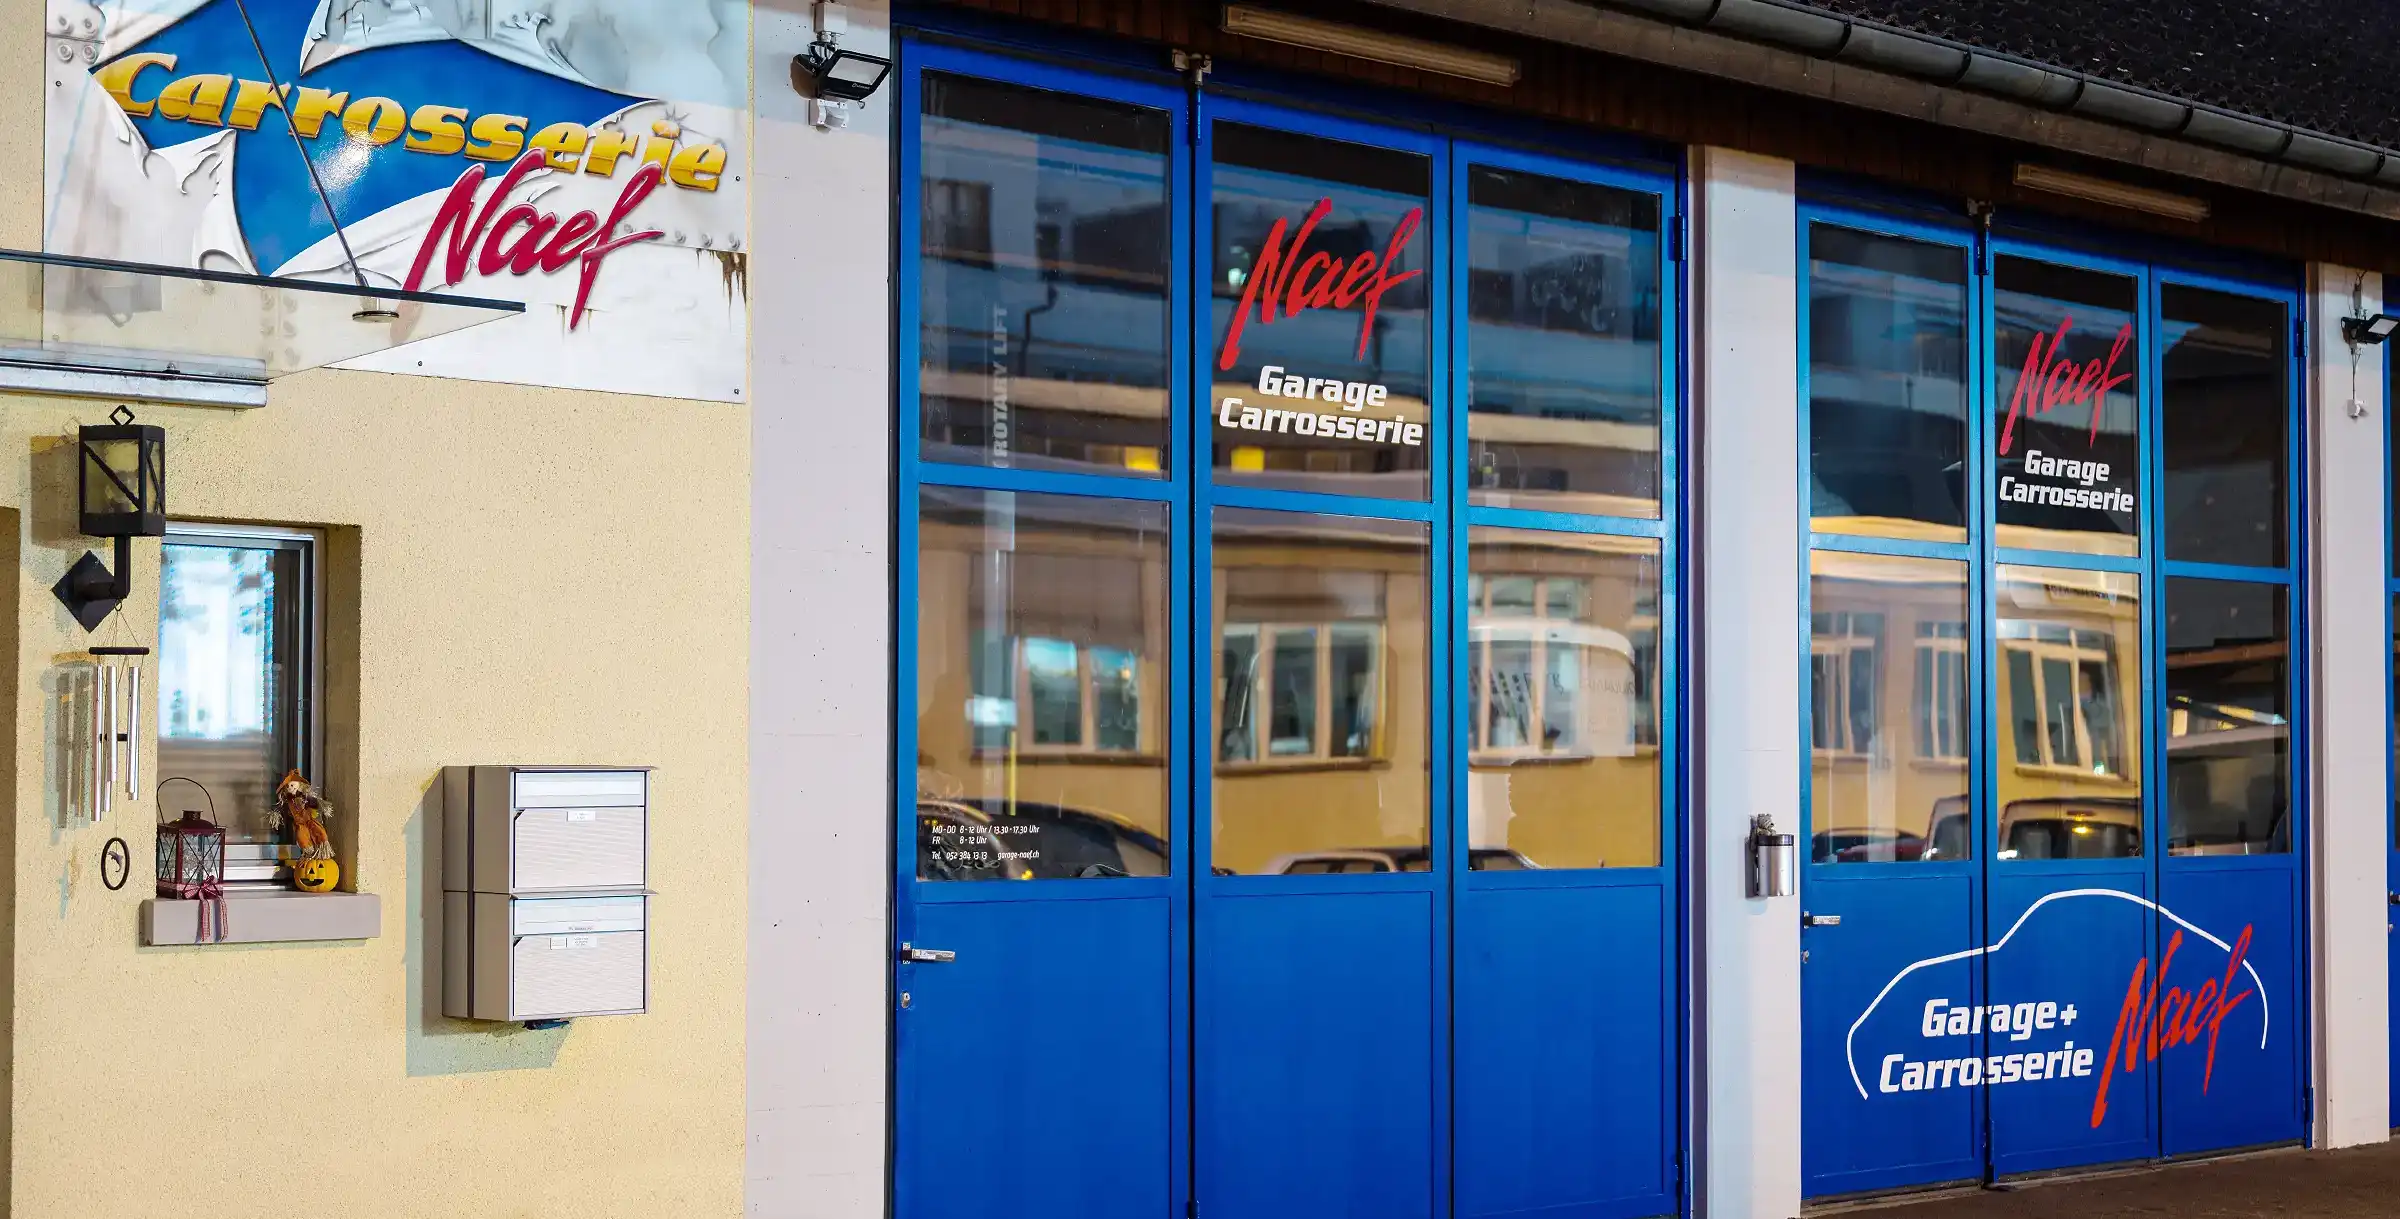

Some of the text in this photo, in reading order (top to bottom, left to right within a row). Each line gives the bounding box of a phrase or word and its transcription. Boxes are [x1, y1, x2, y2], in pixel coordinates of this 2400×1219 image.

[93, 52, 727, 192] Carrosserie
[390, 147, 664, 341] Naef
[1220, 197, 1423, 371] Naef
[1258, 365, 1388, 412] Garage
[2000, 314, 2133, 456] Naef
[1219, 397, 1423, 446] Carrosserie
[2025, 450, 2110, 486] Garage
[2000, 476, 2134, 512] Carrosserie
[932, 836, 941, 844] FR
[976, 836, 988, 844] Uhr
[976, 825, 988, 834] Uhr
[1029, 824, 1040, 833] Uhr
[932, 851, 942, 860] Tel.
[946, 851, 958, 861] 052
[959, 851, 971, 860] 384
[973, 851, 980, 860] 13
[981, 851, 988, 860] 13
[2091, 923, 2253, 1128] Naef
[1879, 1041, 2094, 1093] Carrosserie
